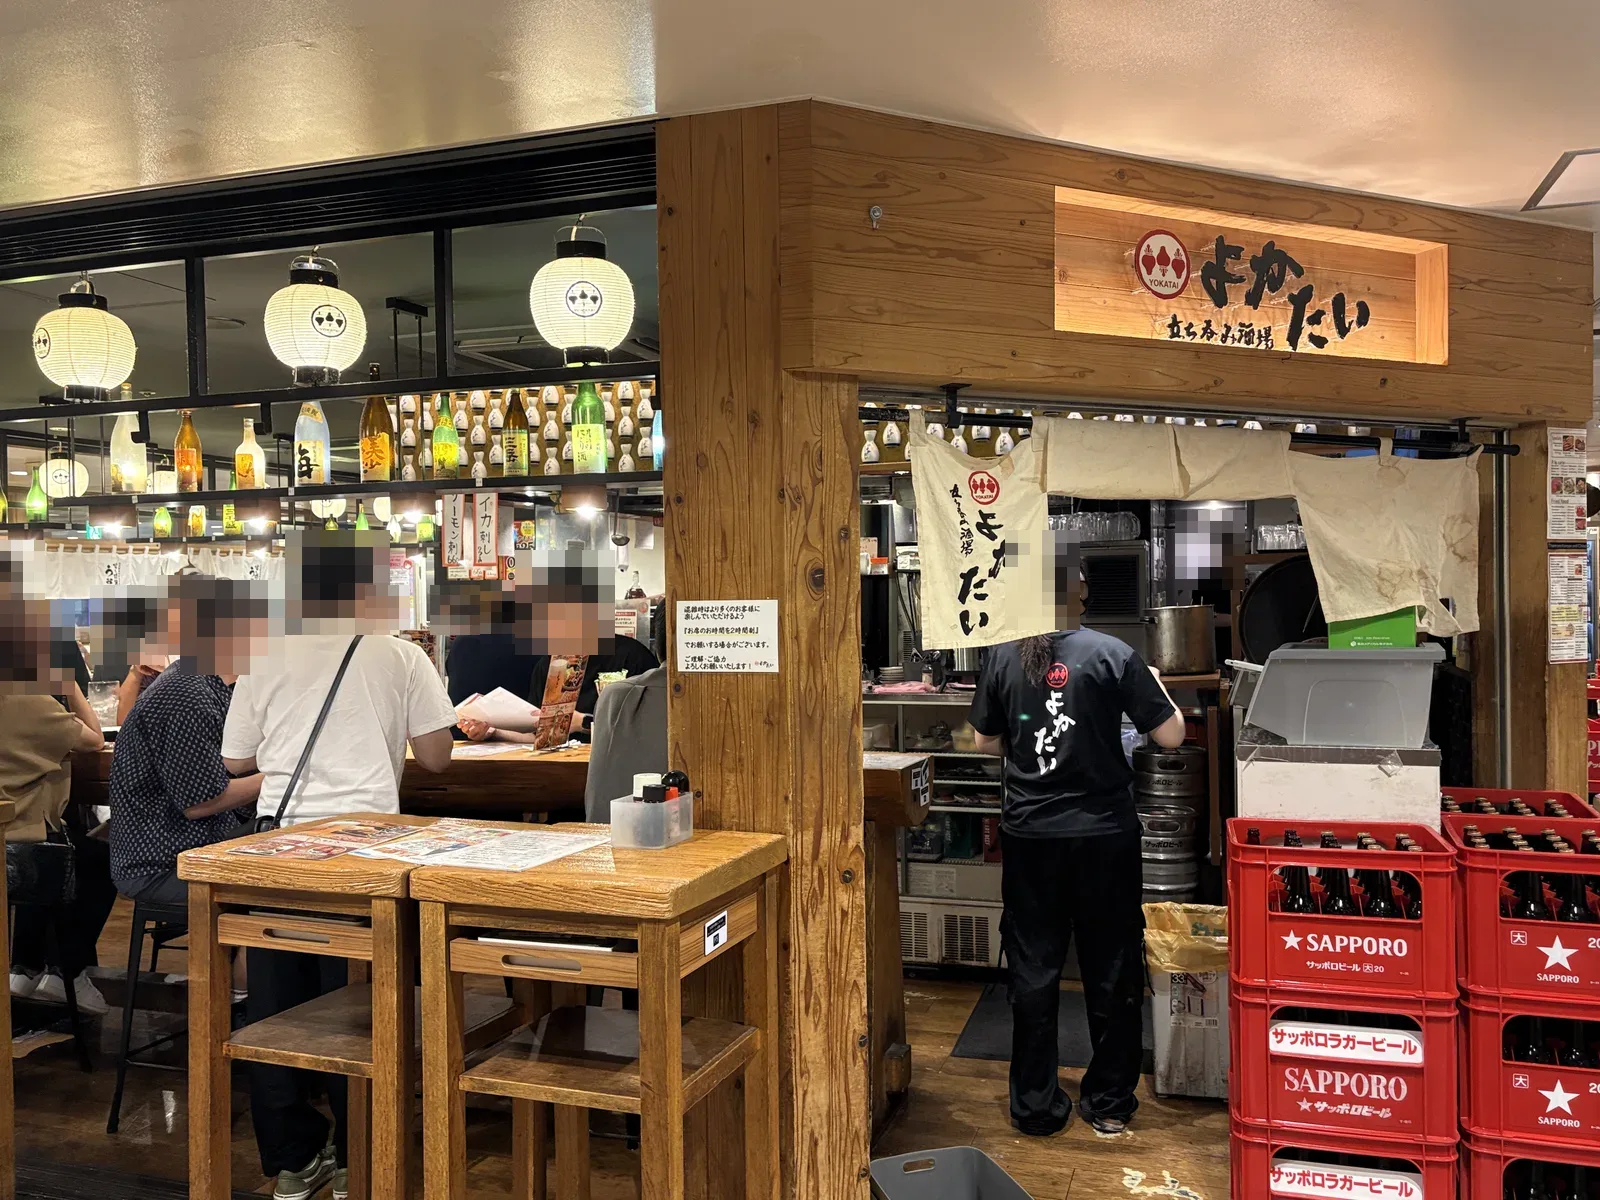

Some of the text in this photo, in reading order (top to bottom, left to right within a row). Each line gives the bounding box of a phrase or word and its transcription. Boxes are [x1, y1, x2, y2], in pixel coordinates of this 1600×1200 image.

[1148, 278, 1179, 289] YOKATAI
[1200, 234, 1370, 352] よかたい
[1166, 313, 1274, 349] 立ち呑み酒場
[479, 496, 492, 555] イカ刺し
[1034, 690, 1076, 775] よかたい
[1306, 933, 1408, 957] SAPPORO
[1511, 931, 1527, 945] 大
[1306, 960, 1361, 973] サッポロビール
[1536, 972, 1580, 984] SAPPORO
[1271, 1028, 1418, 1056] サッポロラガービール
[1284, 1067, 1408, 1102] SAPPORO
[1513, 1074, 1529, 1088] 大
[1313, 1101, 1393, 1120] サッポロビール
[1537, 1115, 1581, 1129] SAPPORO
[1270, 1166, 1414, 1199] サッポロラガービール
